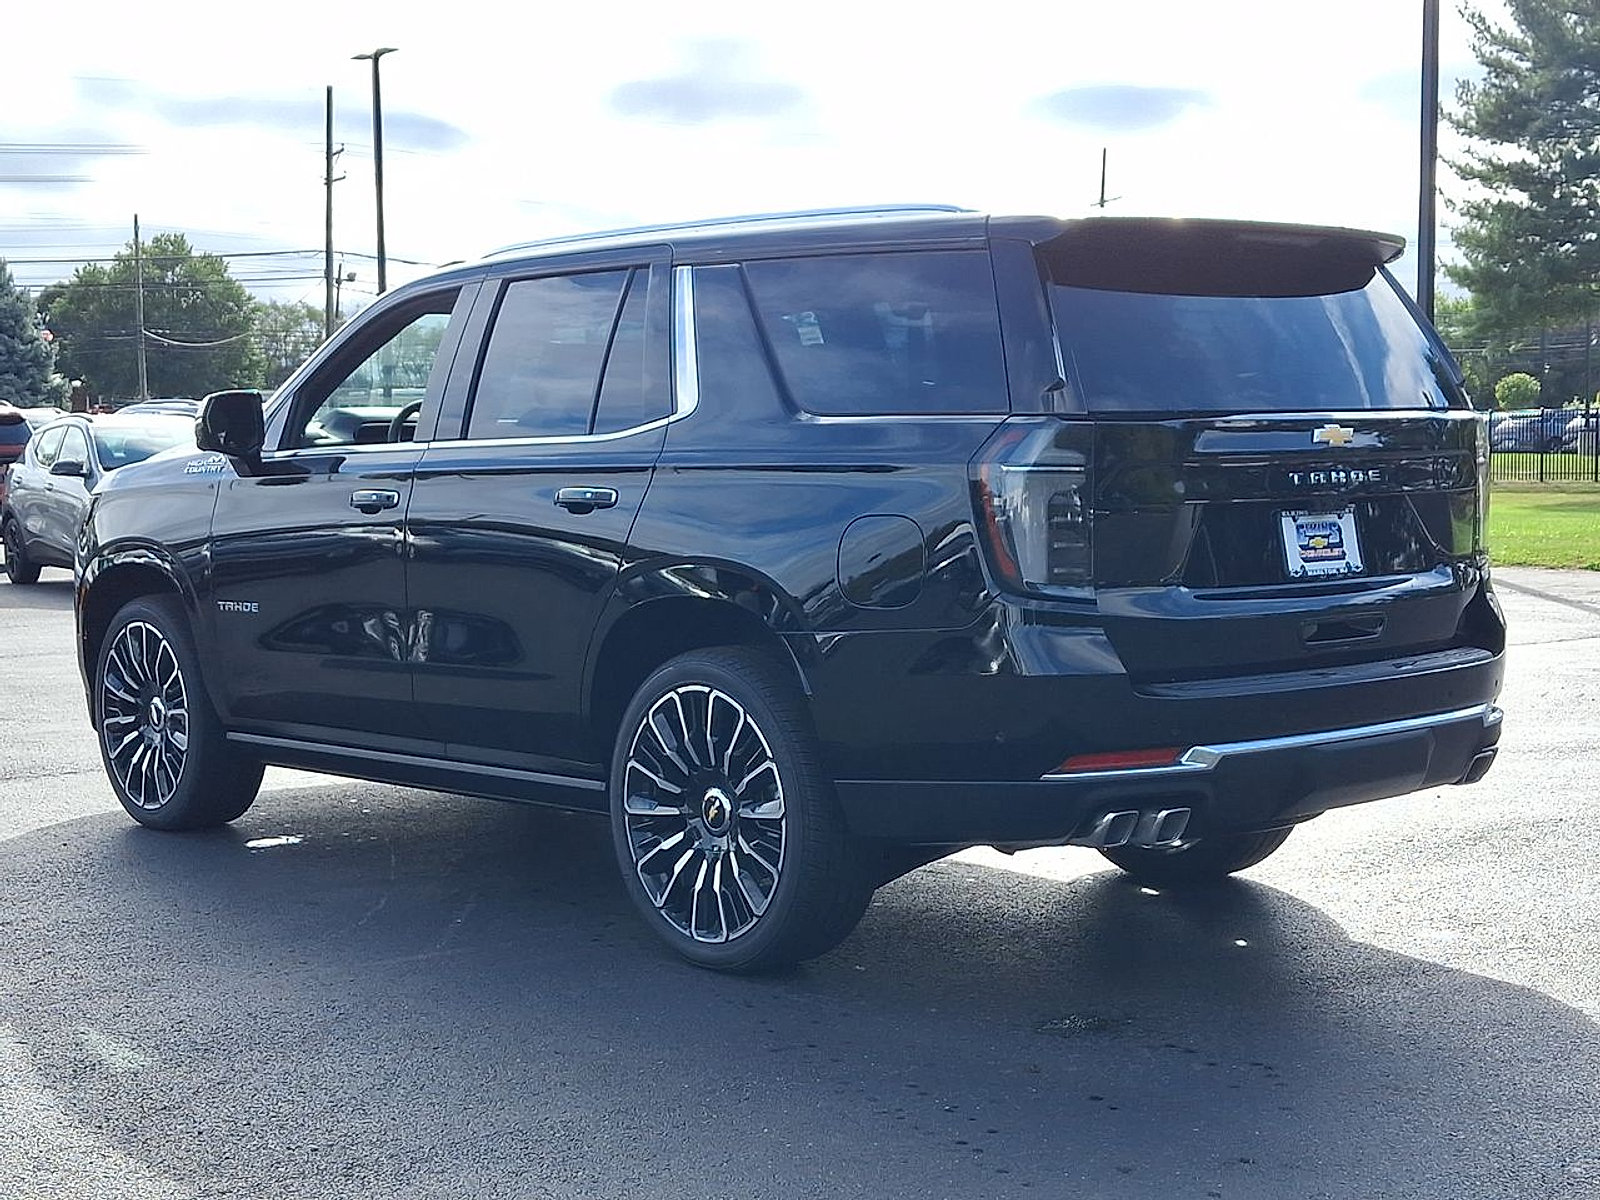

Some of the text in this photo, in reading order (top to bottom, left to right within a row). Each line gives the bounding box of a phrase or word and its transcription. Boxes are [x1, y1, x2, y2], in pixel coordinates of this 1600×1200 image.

[184, 466, 223, 474] COUNTRY
[1288, 469, 1381, 486] TAHOE
[217, 601, 259, 613] TAHOE
